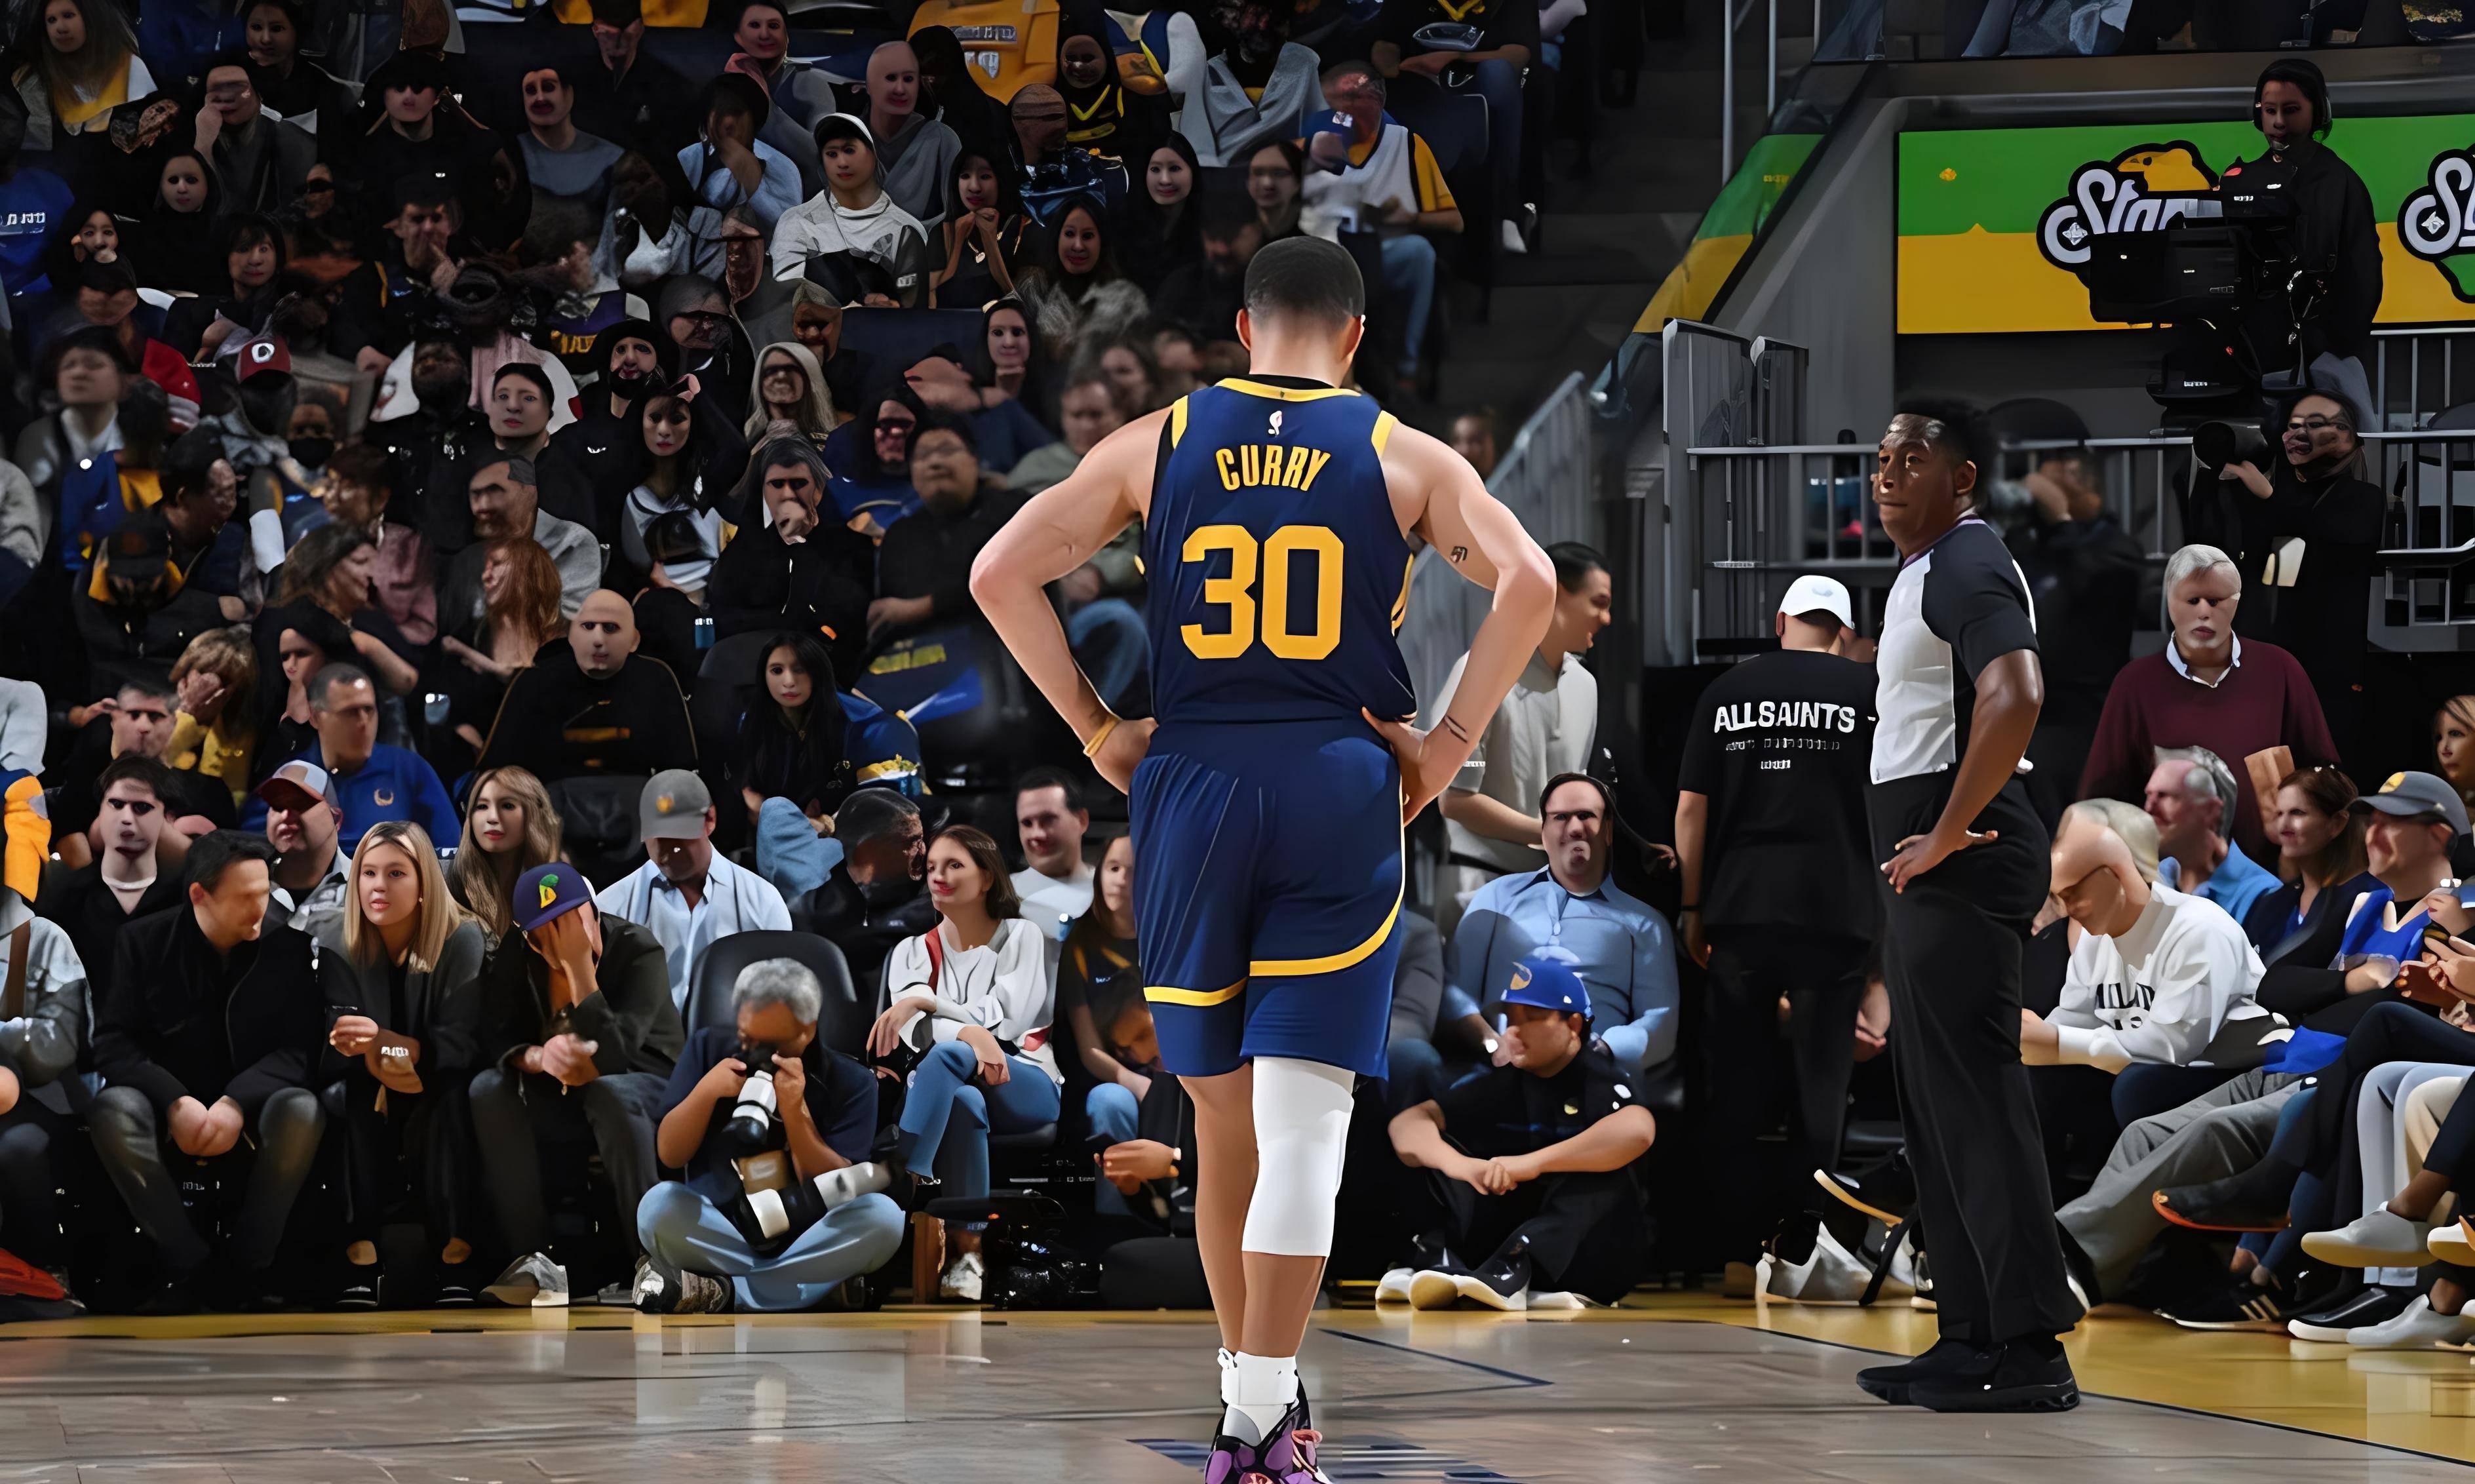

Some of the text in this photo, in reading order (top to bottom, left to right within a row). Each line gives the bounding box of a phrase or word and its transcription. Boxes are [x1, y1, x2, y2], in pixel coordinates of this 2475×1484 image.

[2044, 168, 2225, 264] Star
[1215, 444, 1331, 492] CURRY
[1180, 524, 1344, 660] 30
[1714, 701, 1856, 733] ALLSAINTS
